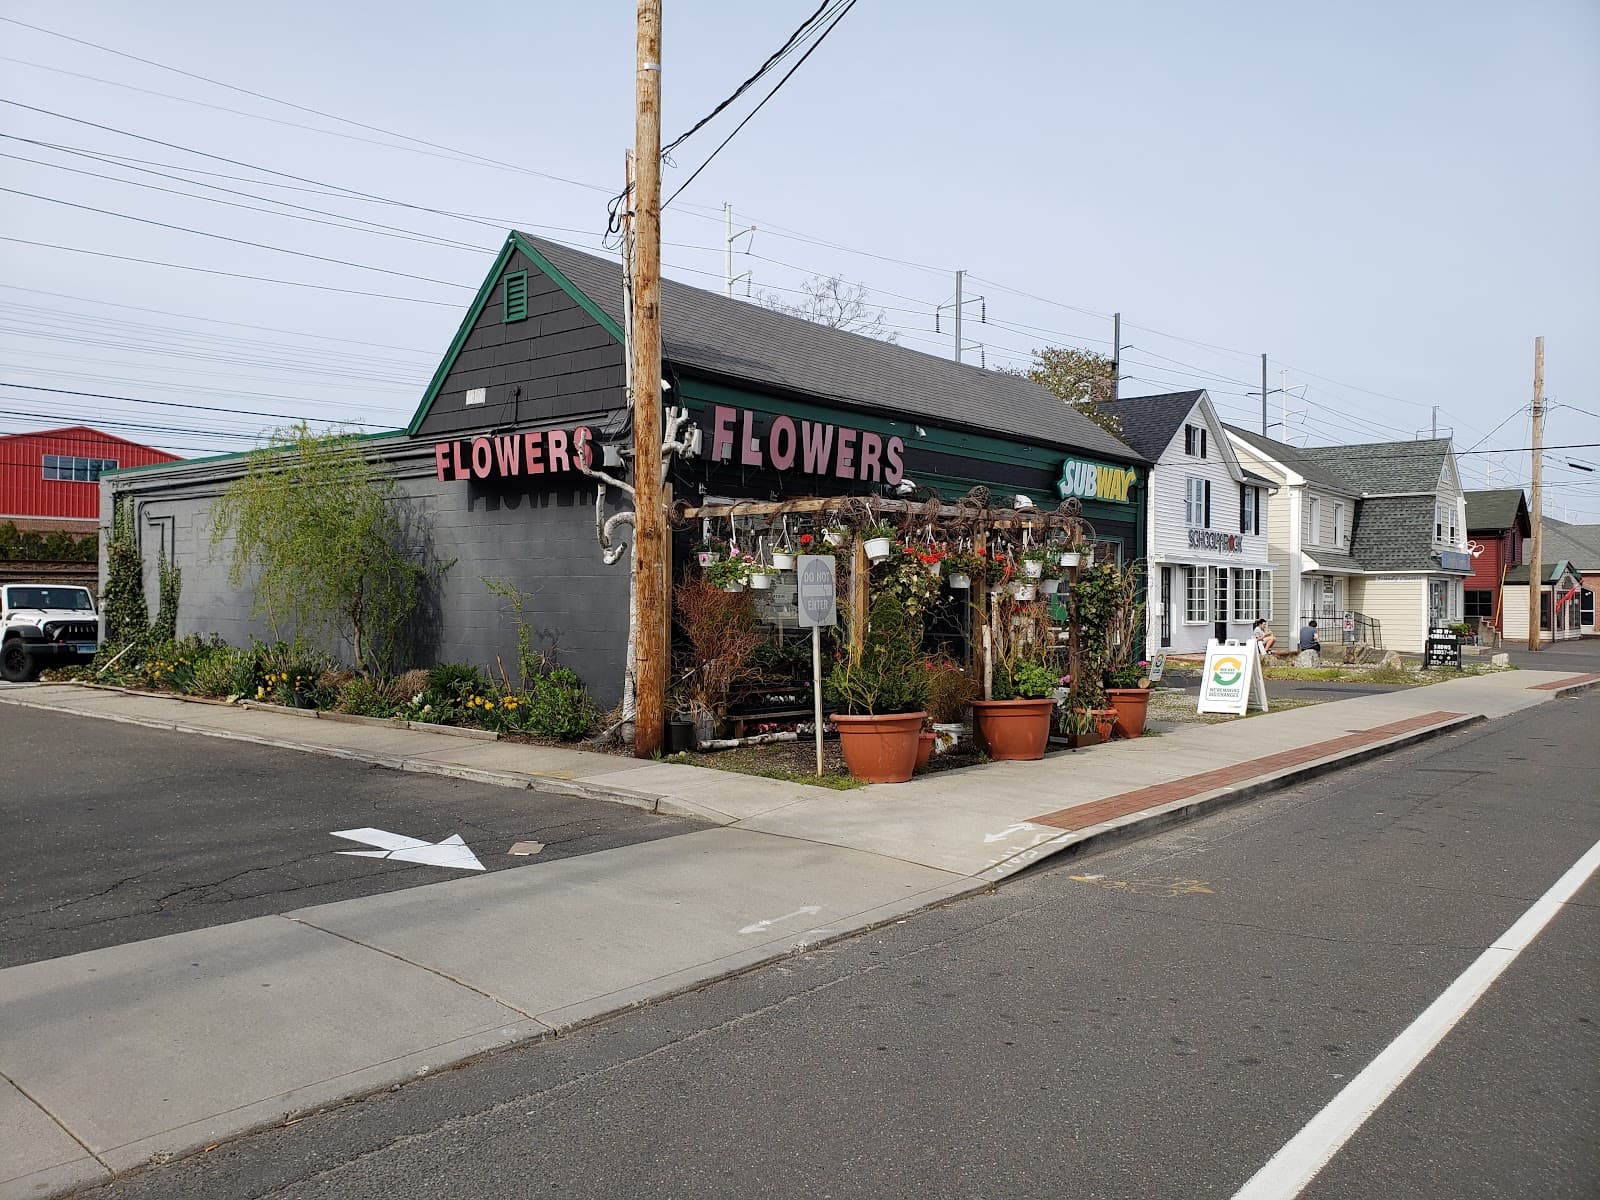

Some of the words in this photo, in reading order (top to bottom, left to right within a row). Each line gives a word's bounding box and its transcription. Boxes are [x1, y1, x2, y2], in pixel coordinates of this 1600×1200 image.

[435, 425, 593, 482] FLOWERS
[711, 405, 904, 486] FLOWERS
[1058, 459, 1137, 503] SUBWAY
[1188, 529, 1217, 549] SCHOOL
[804, 571, 815, 583] DO
[816, 571, 830, 583] NOT
[807, 600, 828, 611] ENTER
